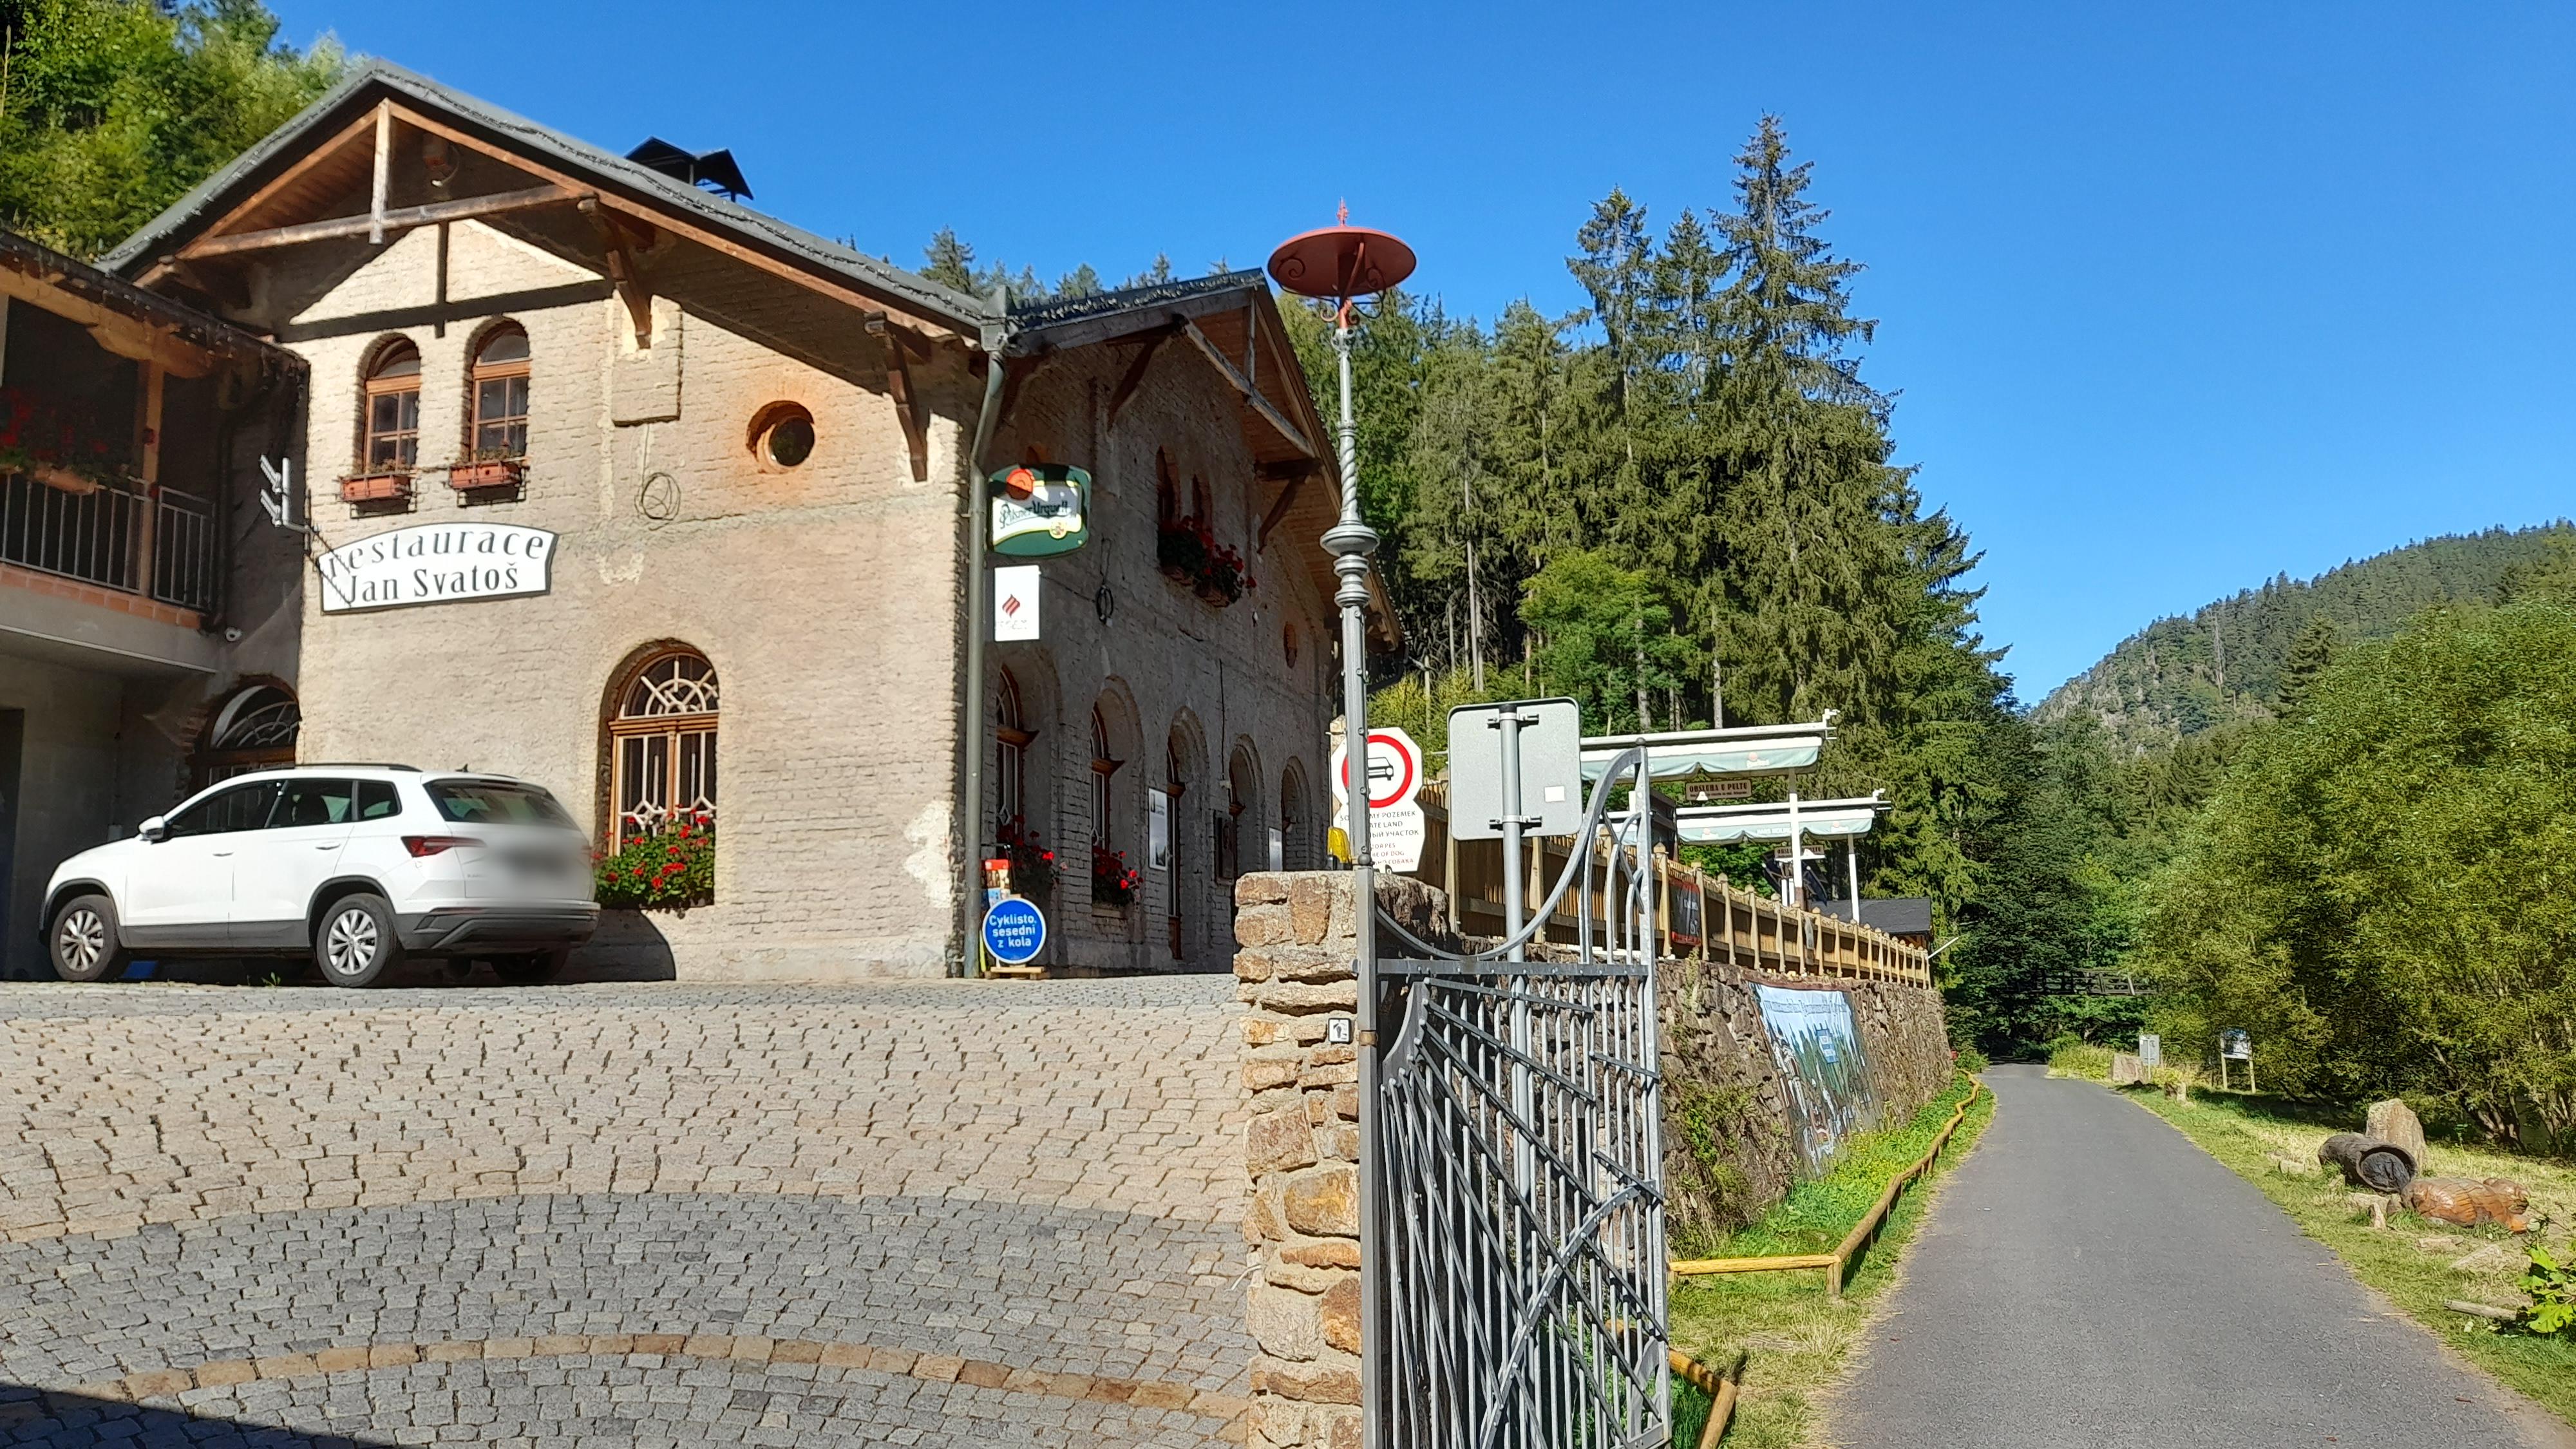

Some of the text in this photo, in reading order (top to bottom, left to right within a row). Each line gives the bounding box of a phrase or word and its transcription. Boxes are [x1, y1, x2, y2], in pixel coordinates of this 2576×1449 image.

[1032, 500, 1071, 518] Urquell
[328, 531, 544, 580] restaurace
[345, 562, 518, 605] Jan Svatoš
[1689, 784, 1719, 793] OBSLUHA
[1382, 810, 1416, 819] POZEMEK
[992, 924, 1036, 938] sesedni
[998, 936, 1032, 949] z kola
